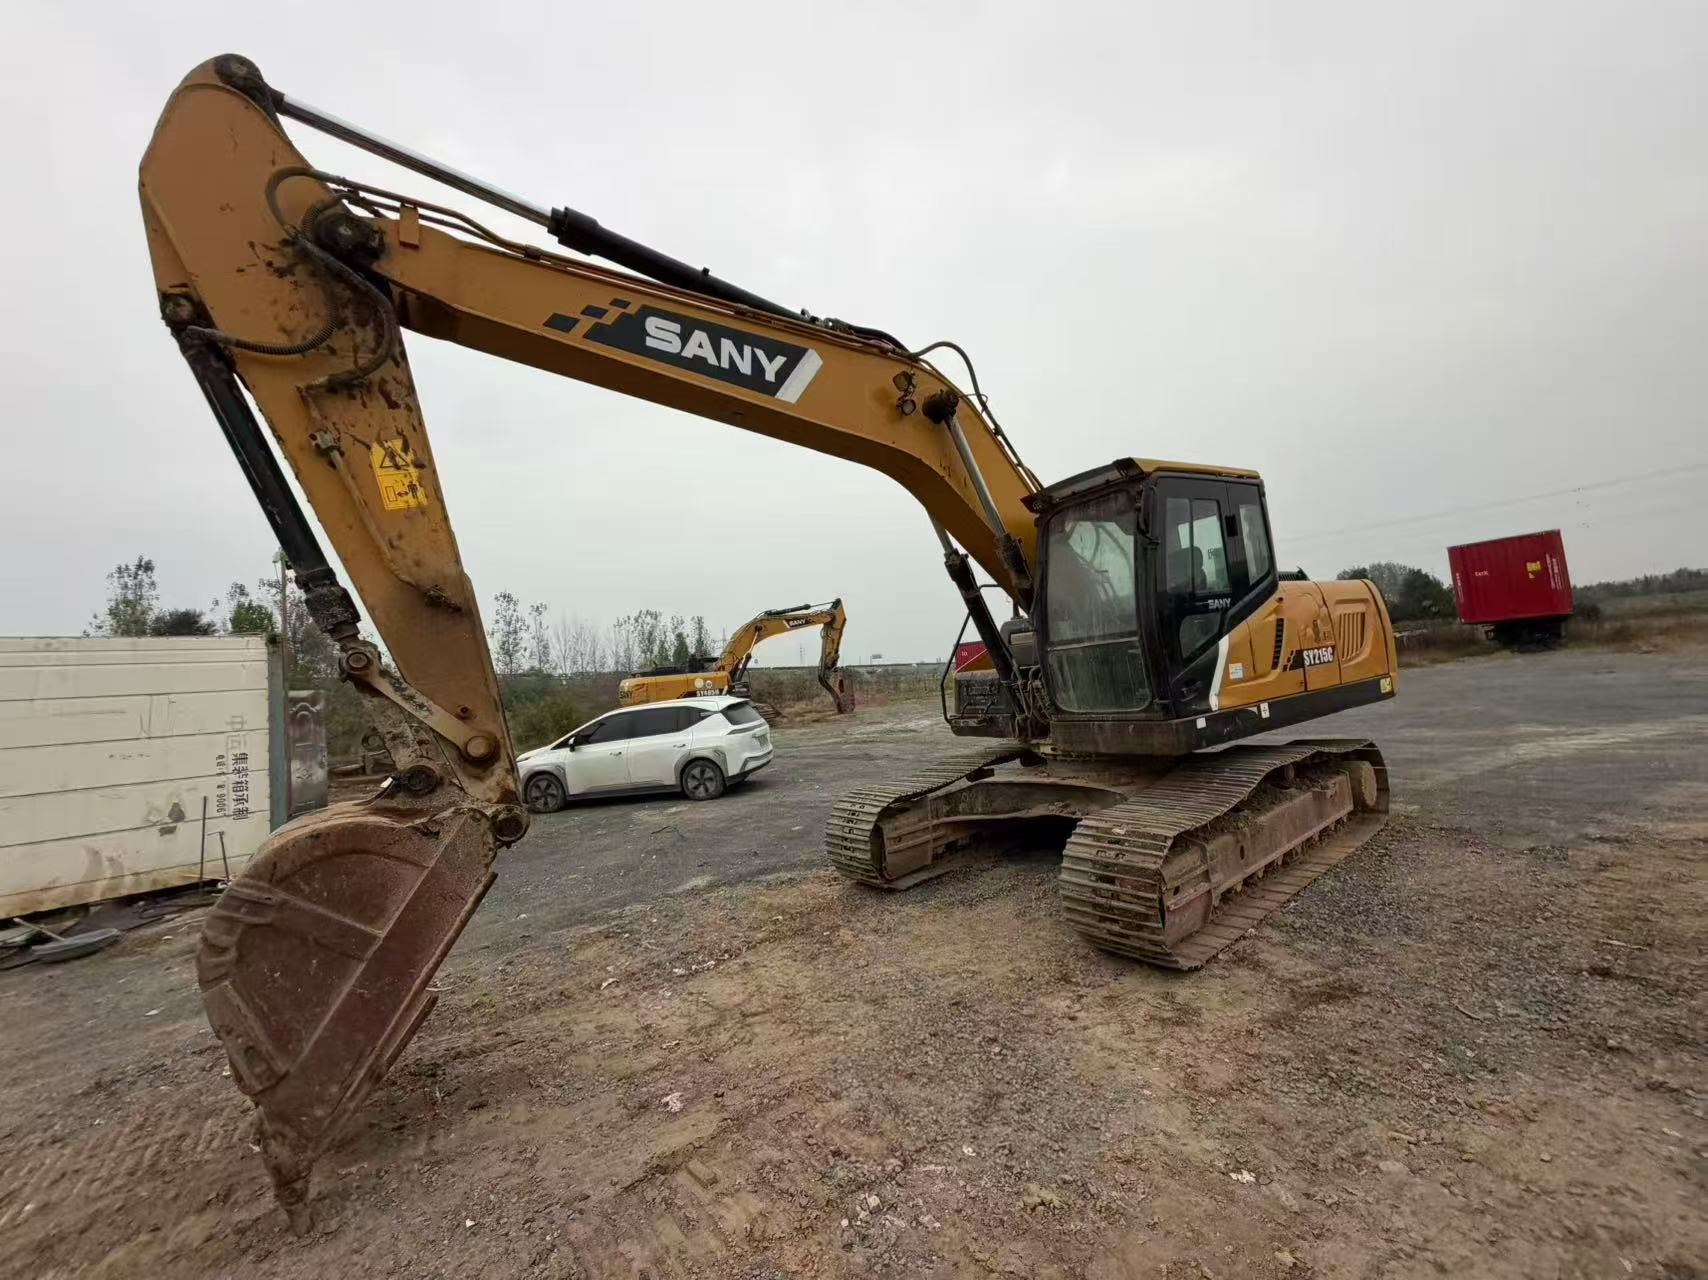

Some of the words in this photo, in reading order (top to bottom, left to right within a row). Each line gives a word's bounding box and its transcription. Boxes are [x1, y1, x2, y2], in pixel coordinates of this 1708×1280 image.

[644, 316, 787, 383] SANY
[1208, 597, 1231, 609] SANY
[1303, 646, 1334, 666] SY215C
